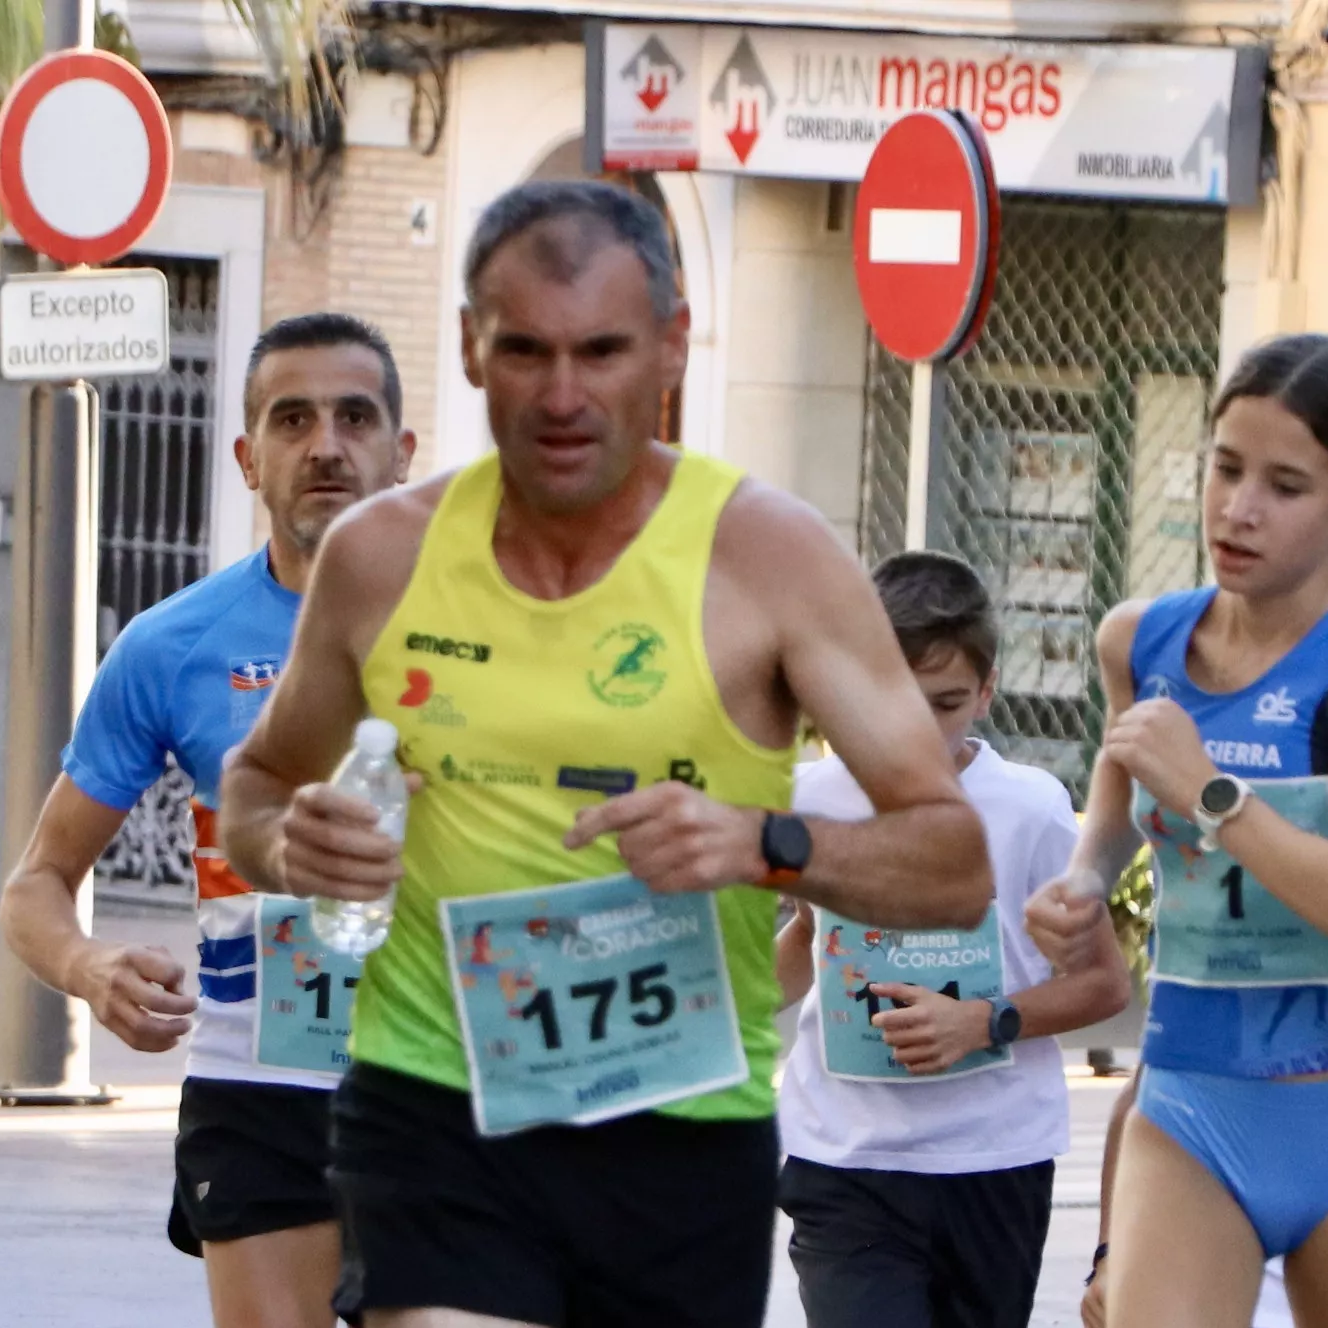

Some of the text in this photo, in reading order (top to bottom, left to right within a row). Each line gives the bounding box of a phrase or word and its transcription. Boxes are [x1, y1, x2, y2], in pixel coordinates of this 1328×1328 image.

[1077, 153, 1175, 180] INMOBILIARIA
[412, 205, 427, 236] 4
[30, 289, 134, 323] Excepto
[8, 335, 158, 365] autorizados
[1204, 739, 1282, 769] SIERRA
[1220, 865, 1244, 919] 1
[903, 934, 960, 948] CARRERA
[522, 961, 677, 1051] 175
